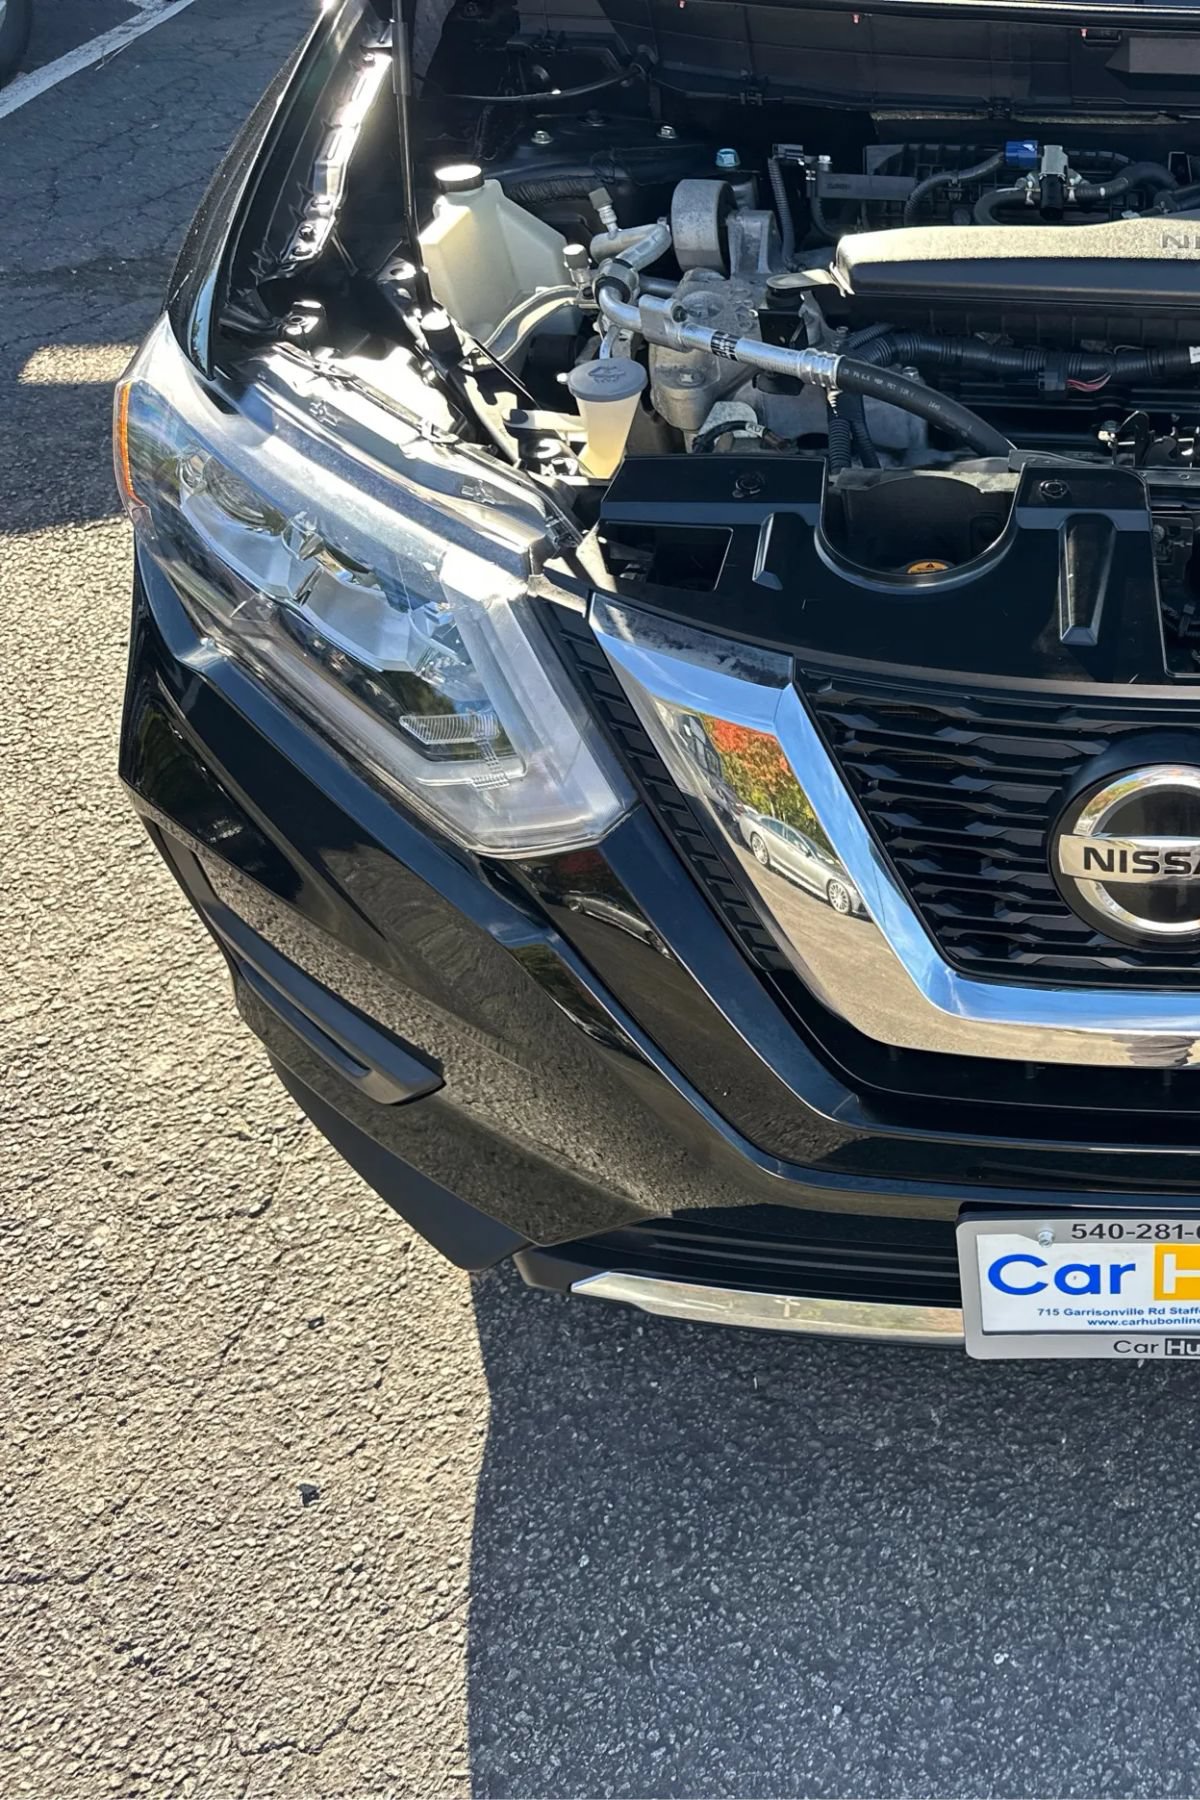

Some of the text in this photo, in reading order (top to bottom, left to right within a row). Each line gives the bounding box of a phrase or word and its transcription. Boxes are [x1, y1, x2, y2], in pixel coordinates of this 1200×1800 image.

[988, 1254, 1136, 1296] Car
[1038, 1308, 1060, 1316] 715
[1063, 1307, 1144, 1316] Garrisonville
[1148, 1307, 1166, 1315] Rd
[1113, 1339, 1159, 1353] Car
